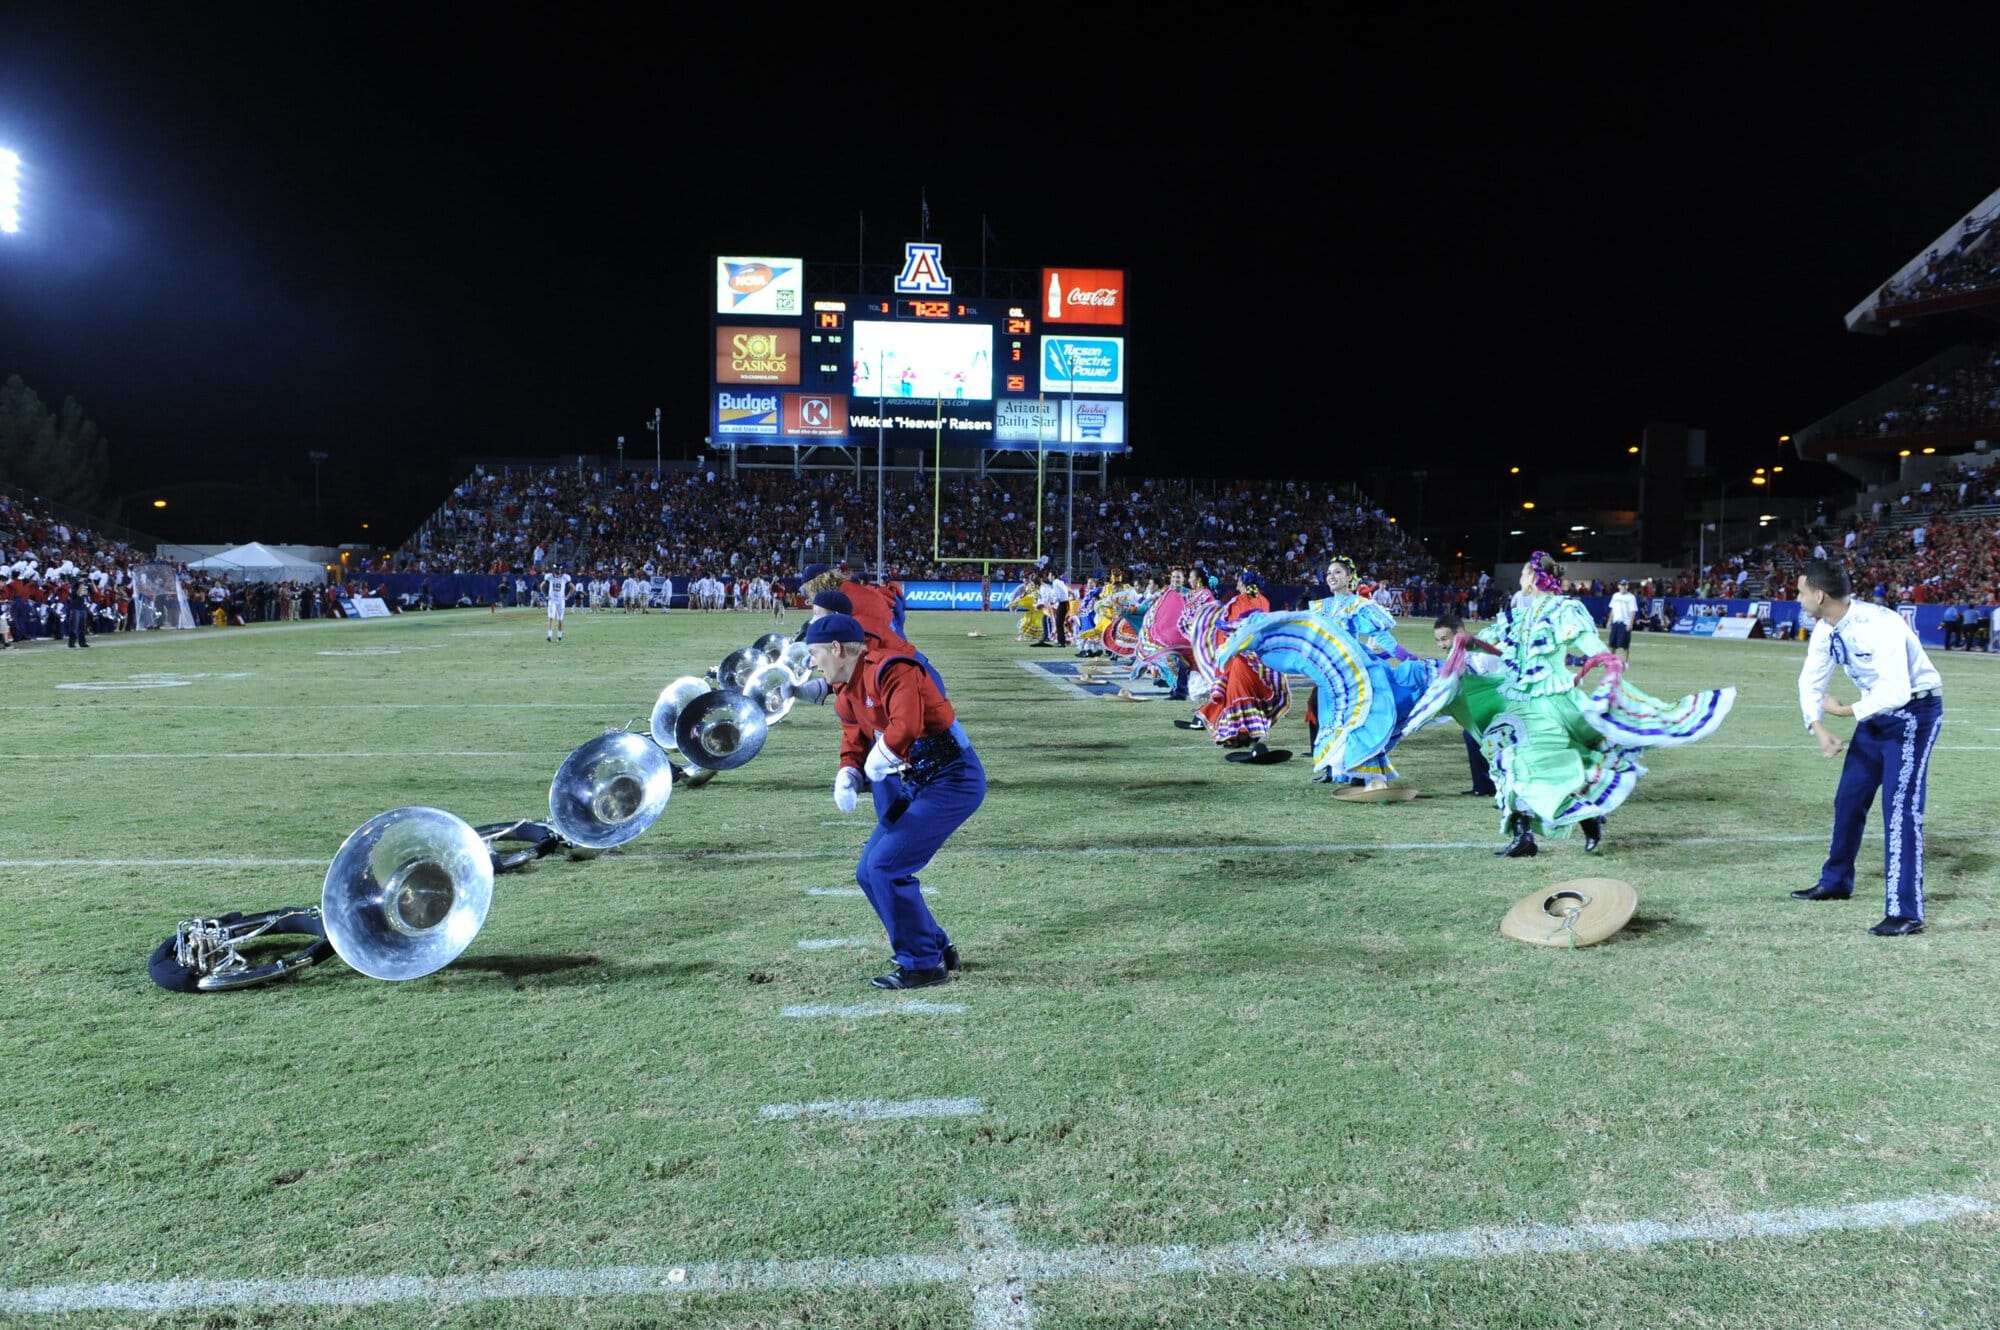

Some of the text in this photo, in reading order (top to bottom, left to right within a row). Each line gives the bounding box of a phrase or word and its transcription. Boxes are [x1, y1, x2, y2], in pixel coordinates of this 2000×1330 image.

[895, 243, 951, 294] A
[881, 302, 889, 314] 3
[909, 301, 949, 317] 7:22
[958, 305, 965, 316] 3
[1008, 320, 1030, 334] 24
[732, 334, 787, 360] SOL
[1063, 344, 1102, 357] Tucson
[1012, 350, 1021, 361] 3
[1067, 355, 1113, 368] Electric
[732, 360, 787, 372] CASINOS
[1072, 366, 1112, 377] Power
[719, 393, 777, 415] Budget
[1004, 401, 1050, 414] Arizona
[850, 416, 894, 428] Wildcat
[949, 418, 992, 430] Raisers
[997, 415, 1029, 429] Daily
